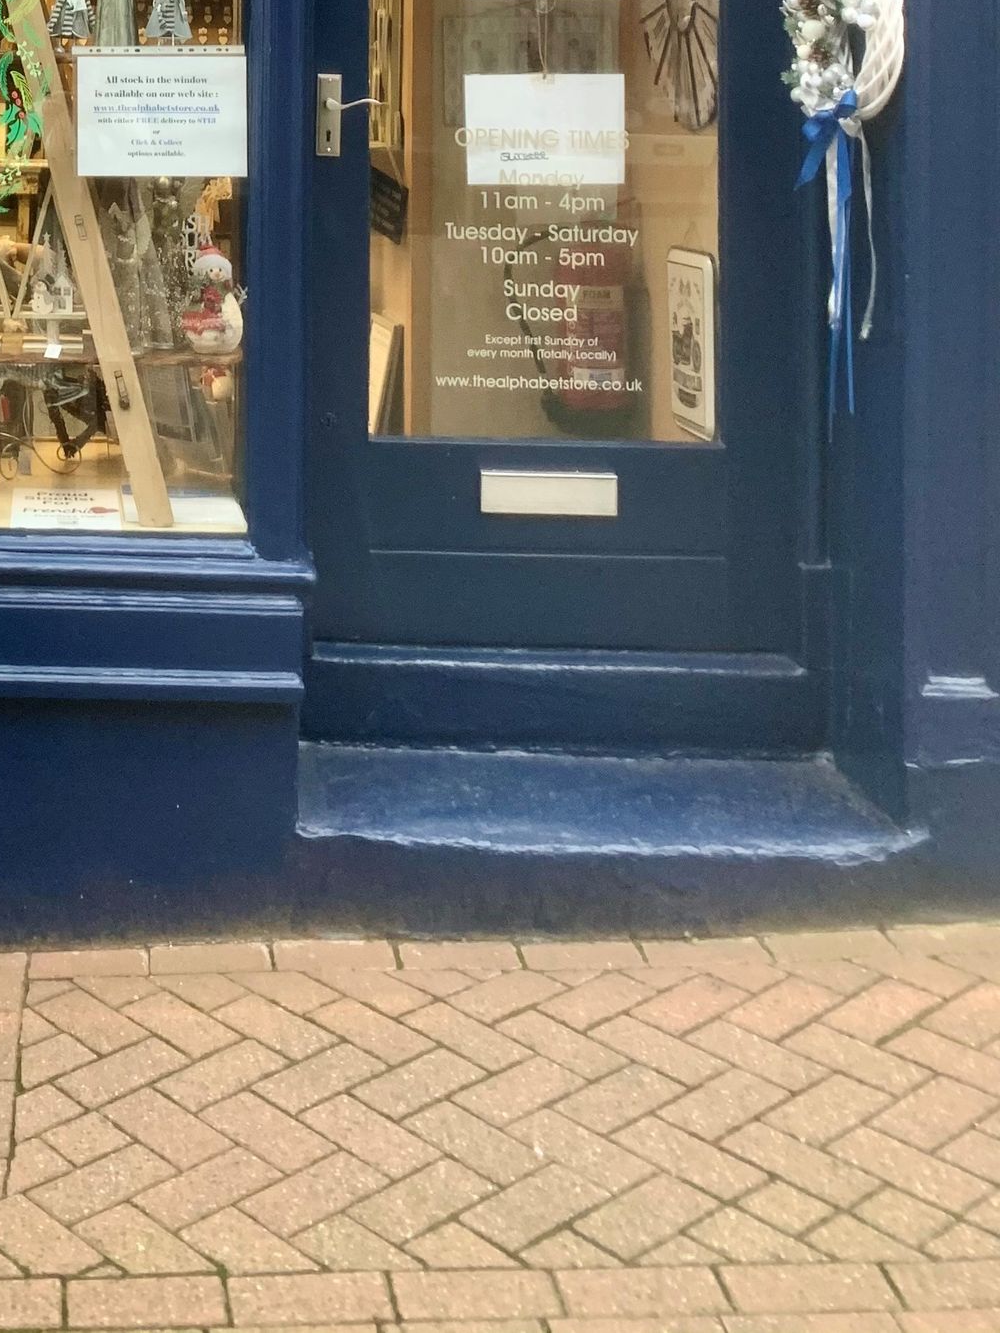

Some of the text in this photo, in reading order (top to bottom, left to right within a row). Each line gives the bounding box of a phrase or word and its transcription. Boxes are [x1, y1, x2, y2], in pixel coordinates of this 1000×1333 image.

[105, 75, 208, 85] All stock in the window
[94, 89, 103, 99] is
[104, 89, 144, 99] available
[146, 91, 158, 99] on
[159, 91, 175, 99] our
[177, 89, 195, 99] web
[197, 89, 213, 99] site
[454, 126, 631, 151] OPENING TIMES
[500, 169, 585, 191] Monday
[480, 191, 538, 210] 11am
[559, 193, 605, 214] 4pm
[445, 222, 528, 245] Tuesday
[548, 224, 639, 247] Saturday
[480, 246, 538, 266] 10am
[559, 248, 605, 269] 5pm
[503, 278, 581, 302] Sunday
[505, 303, 578, 323] Closed
[485, 334, 599, 348] Except first Sunday of
[467, 349, 617, 363] every month (Totally Locally)
[435, 374, 643, 392] www.thealphabetstore.co.uk
